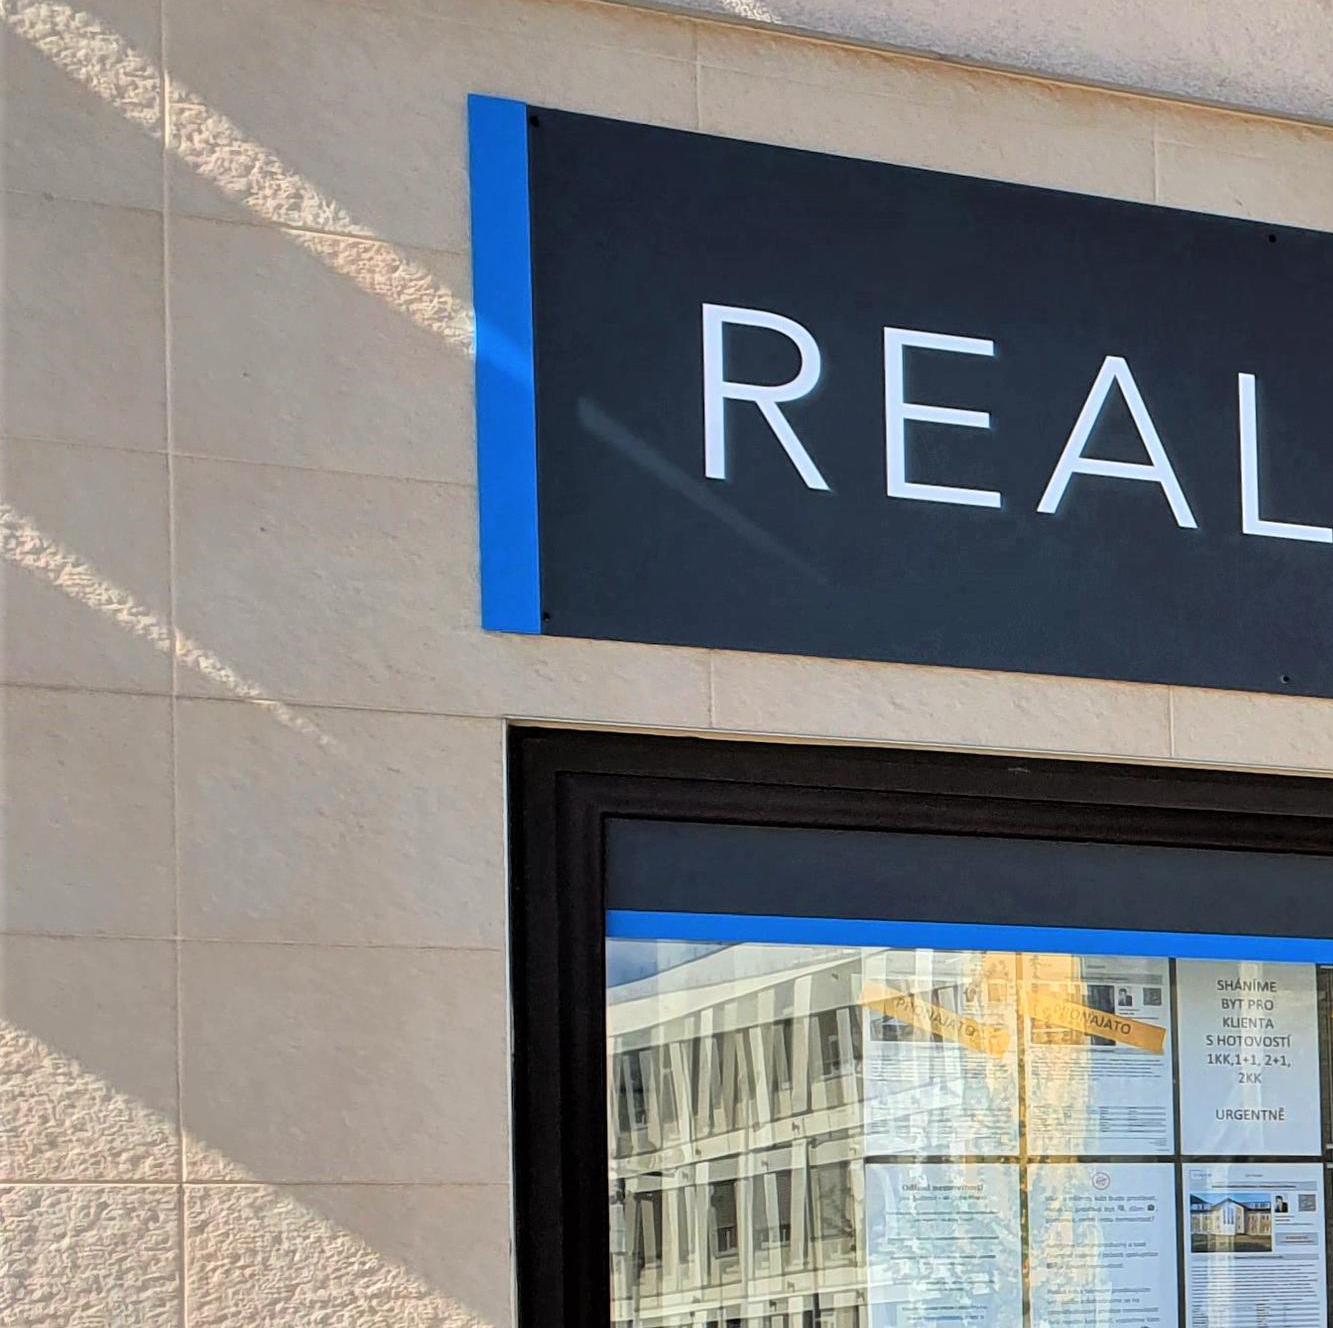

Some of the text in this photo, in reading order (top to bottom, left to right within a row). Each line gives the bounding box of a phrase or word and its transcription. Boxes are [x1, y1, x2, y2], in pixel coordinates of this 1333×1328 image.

[1216, 977, 1277, 993] SHÁNÍME
[1221, 998, 1274, 1011] BYT PRO
[1222, 1017, 1275, 1029] KLIENTA
[1206, 1034, 1291, 1048] S HOTOVOSTÍ
[1238, 1073, 1262, 1084] 2KK
[1215, 1107, 1285, 1121] URGENTNĚ
